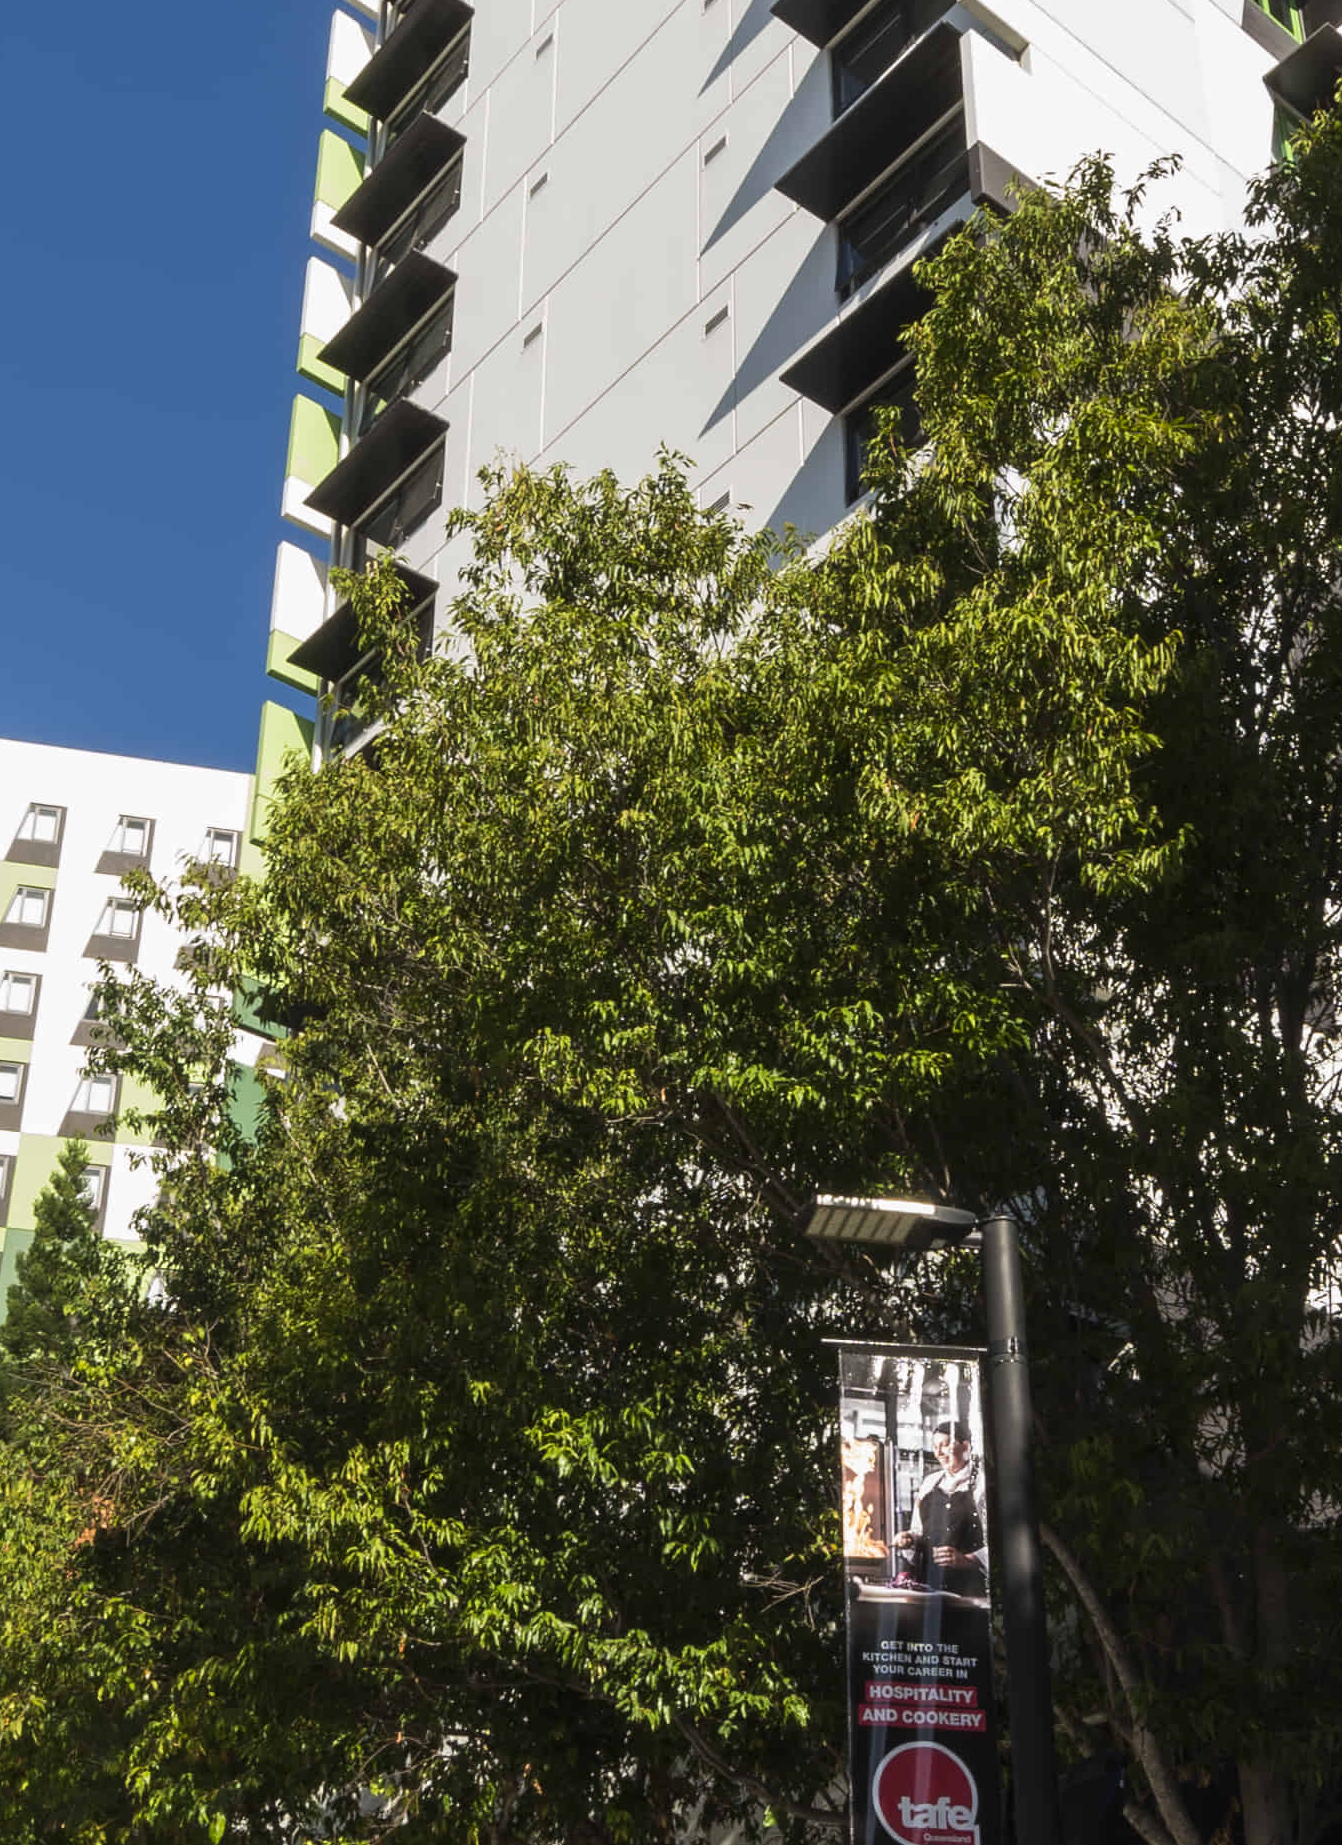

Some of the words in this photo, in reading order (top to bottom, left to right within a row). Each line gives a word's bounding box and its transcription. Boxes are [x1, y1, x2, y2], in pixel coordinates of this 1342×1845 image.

[880, 1640, 903, 1652] GET
[906, 1642, 933, 1653] INTO
[937, 1643, 959, 1655] THE
[862, 1652, 912, 1664] KITCHEN
[914, 1654, 939, 1665] AND
[942, 1655, 978, 1667] START
[872, 1664, 904, 1675] YOUR
[907, 1666, 953, 1677] CAREER
[956, 1668, 968, 1679] IN
[869, 1685, 974, 1703] HOSPITALITY
[862, 1707, 898, 1723] AND
[902, 1710, 982, 1727] COOKERY
[898, 1796, 974, 1830] tafe
